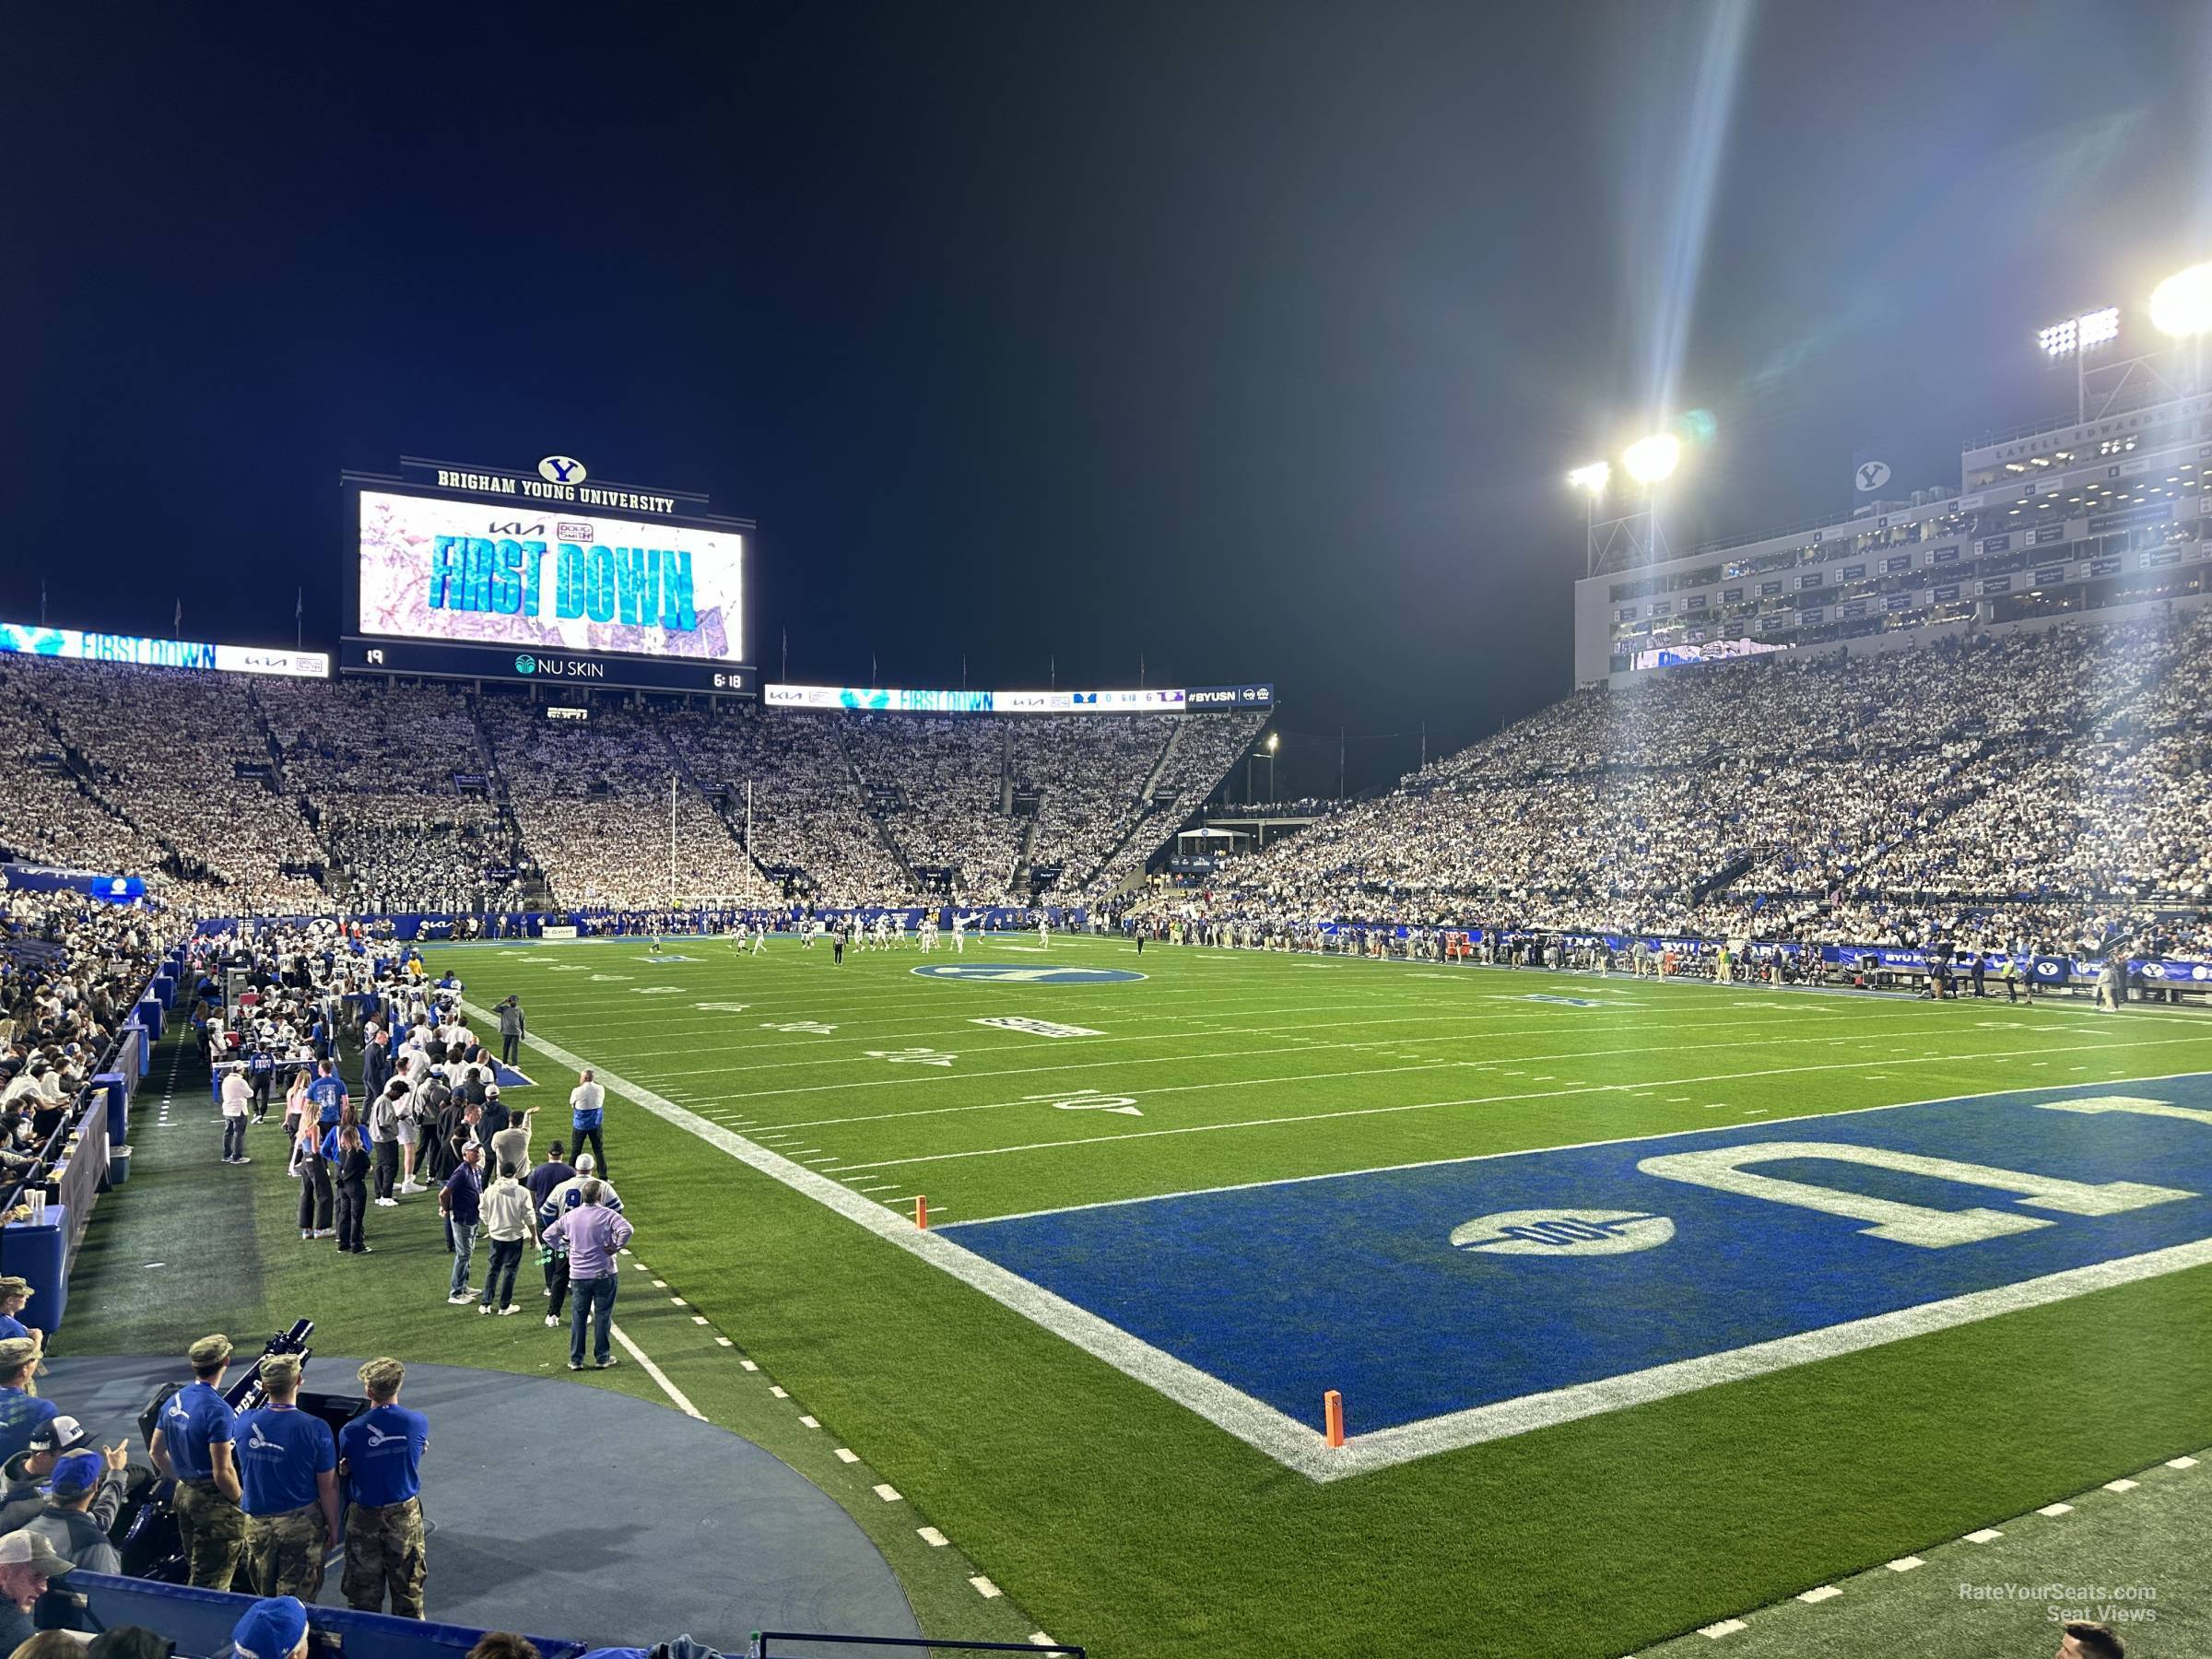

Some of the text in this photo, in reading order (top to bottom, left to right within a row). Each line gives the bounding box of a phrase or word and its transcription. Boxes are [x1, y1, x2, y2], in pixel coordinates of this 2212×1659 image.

[1996, 438, 2061, 459] LAVELL
[547, 459, 579, 483] Y
[1859, 464, 1887, 491] Y
[438, 470, 675, 514] BRIGHAM YOUNG UNIVERSITY
[489, 522, 545, 535] KIA
[559, 524, 591, 533] DOUG
[429, 535, 697, 632] FIRST DOWN
[82, 632, 216, 670] FIRST DOWN
[367, 650, 382, 665] 19
[538, 659, 604, 678] NU SKIN
[714, 674, 742, 688] 6:18
[770, 691, 802, 700] KIA
[900, 690, 994, 712] FIRST DOWN
[1188, 691, 1236, 702] #BYUSN
[547, 707, 588, 720] ESPN
[410, 992, 421, 1002] 30
[1021, 1088, 1139, 1110] 10
